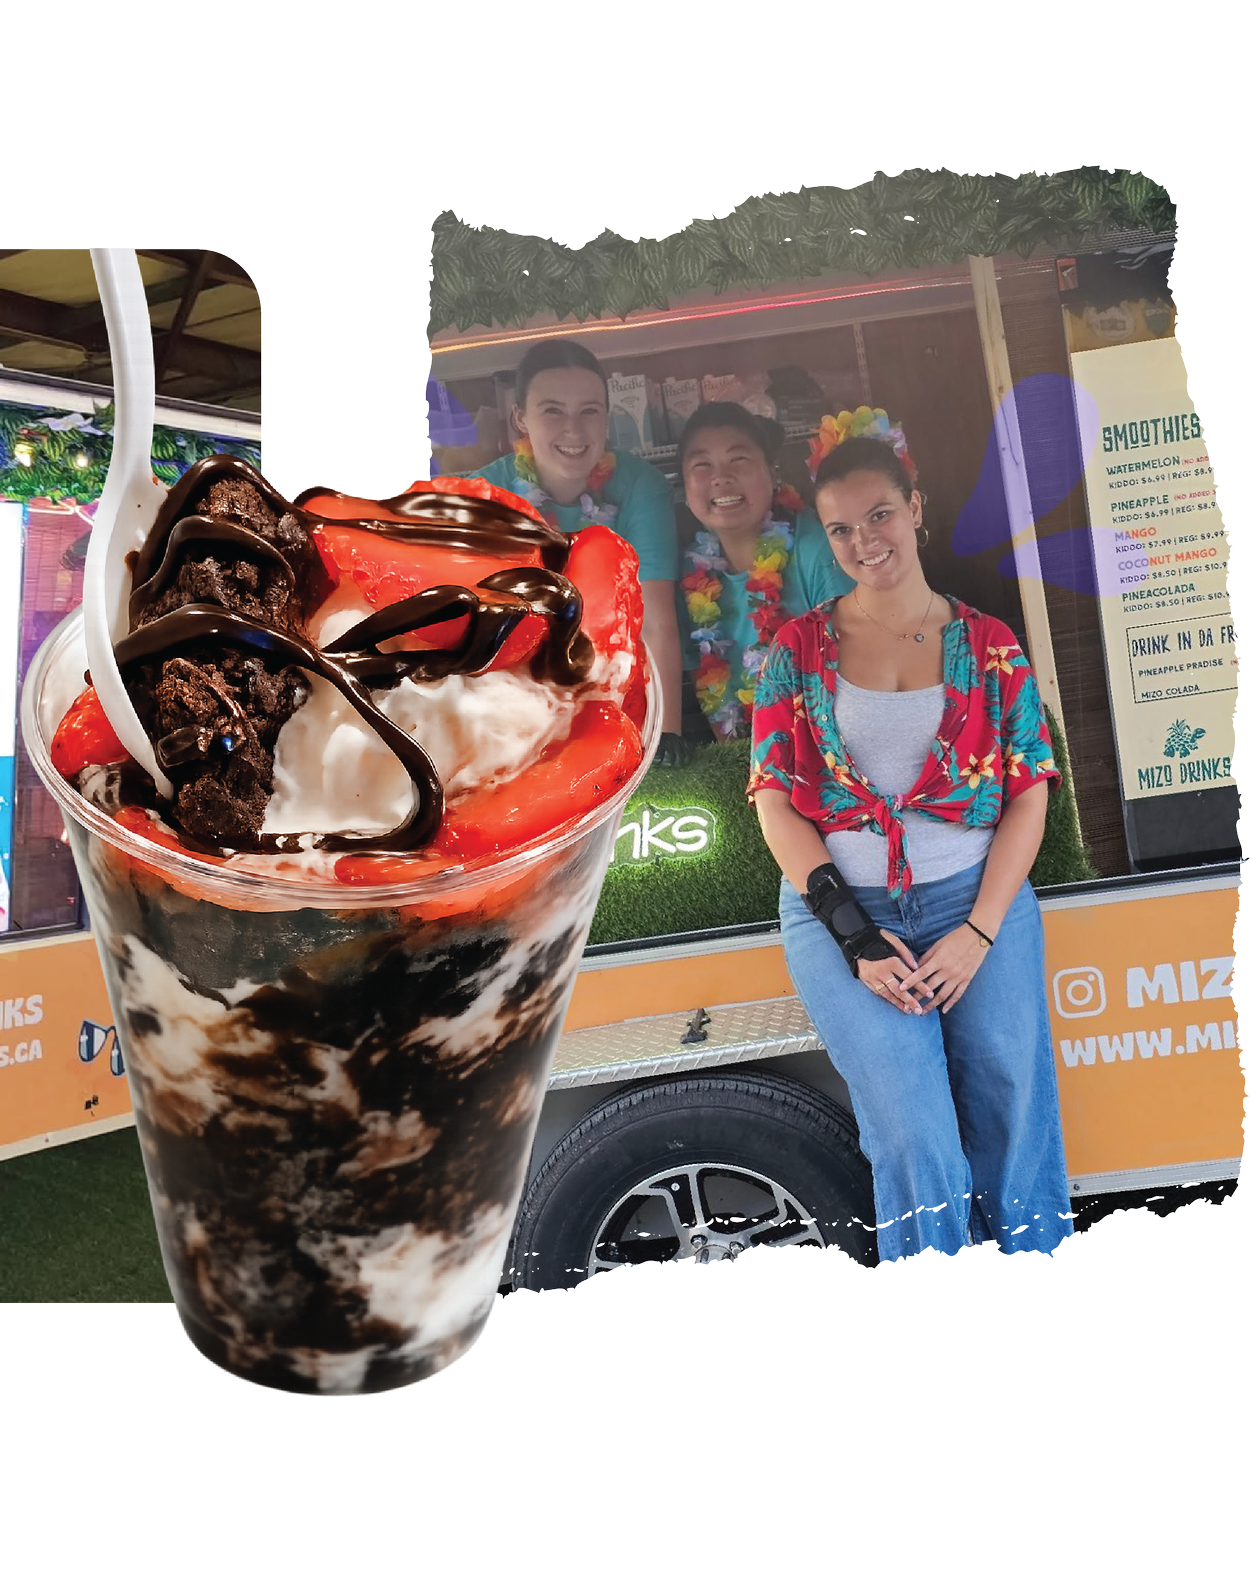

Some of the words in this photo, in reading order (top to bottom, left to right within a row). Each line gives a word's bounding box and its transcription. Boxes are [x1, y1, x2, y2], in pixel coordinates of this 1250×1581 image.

[610, 376, 645, 393] Pacific
[664, 381, 697, 397] Pacific
[1102, 412, 1201, 452] SMOOTHIES
[1106, 456, 1181, 475] WATERMELON
[1109, 478, 1139, 489] KIDDO:
[1141, 474, 1166, 484] $6.99
[1172, 470, 1192, 480] REG:
[1194, 466, 1215, 476] $8.9
[1111, 494, 1169, 512] PINEAPPLE
[1112, 513, 1142, 523] KIDDO:
[1144, 509, 1169, 519] $6.99
[1175, 505, 1195, 514] REG:
[1197, 501, 1219, 511] $8.9
[1114, 527, 1157, 541] MANGO
[1115, 543, 1145, 553] KIDDO:
[1148, 538, 1172, 548] $7.99
[1178, 534, 1198, 543] REG:
[1200, 530, 1225, 541] $9.99
[1118, 555, 1171, 571] COCONUT
[1175, 547, 1217, 562] MANGO
[1120, 573, 1150, 584] KIDDO:
[1151, 569, 1176, 580] $8.50
[1183, 565, 1203, 574] REG:
[1122, 582, 1196, 602] PINEACOLADA
[1123, 602, 1153, 613] KIDDO:
[1155, 598, 1180, 608] $8.50
[1186, 594, 1206, 604] REG:
[1132, 634, 1171, 657] DRINK
[1177, 630, 1192, 651] IN
[1198, 627, 1214, 647] DA
[1138, 663, 1184, 677] PINEAPPLE
[1186, 658, 1223, 670] PRADISE
[1141, 689, 1163, 700] MIZO
[1165, 684, 1200, 696] COLADA
[1137, 764, 1173, 790] MIZO
[1179, 756, 1231, 784] DRINKS
[1126, 955, 1235, 1009] MIZ
[1059, 1020, 1238, 1068] WWW.MI
